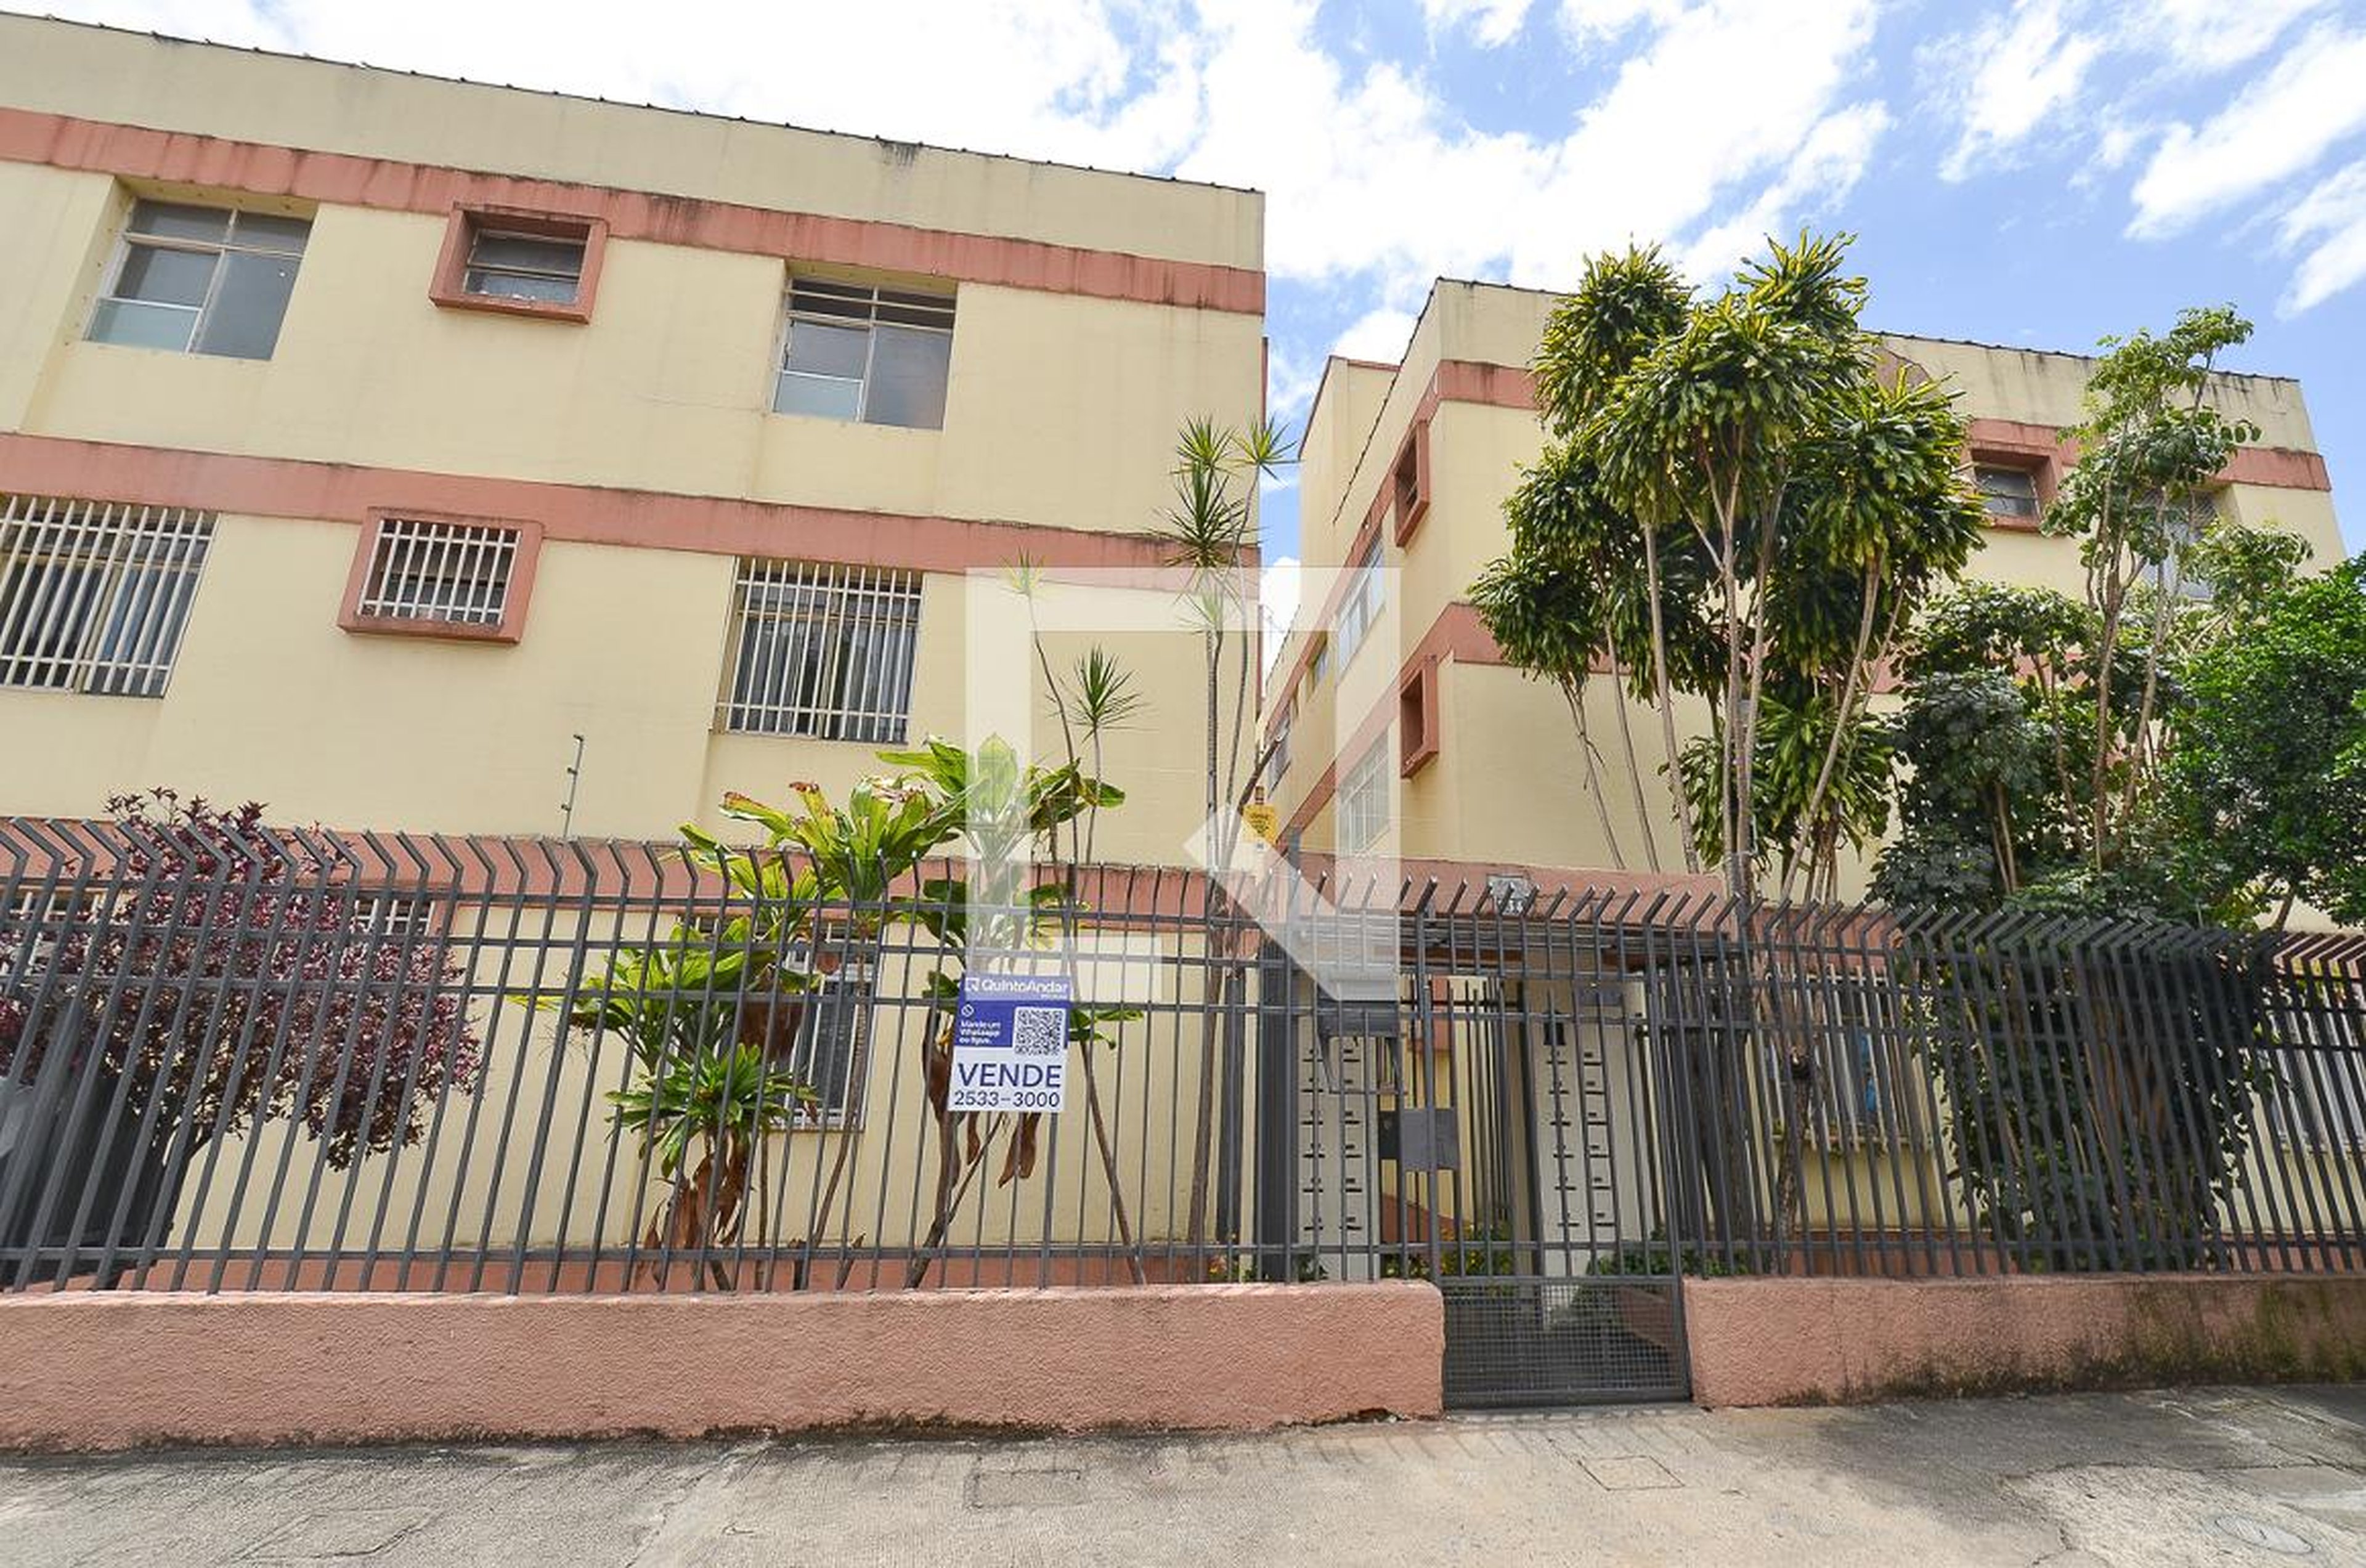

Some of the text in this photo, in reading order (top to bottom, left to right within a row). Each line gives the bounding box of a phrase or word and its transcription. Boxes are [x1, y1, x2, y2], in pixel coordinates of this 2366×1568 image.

[982, 979, 1068, 994] QuintoAndar
[958, 1063, 1062, 1088] VENDE
[954, 1091, 1060, 1108] 2533-3000
